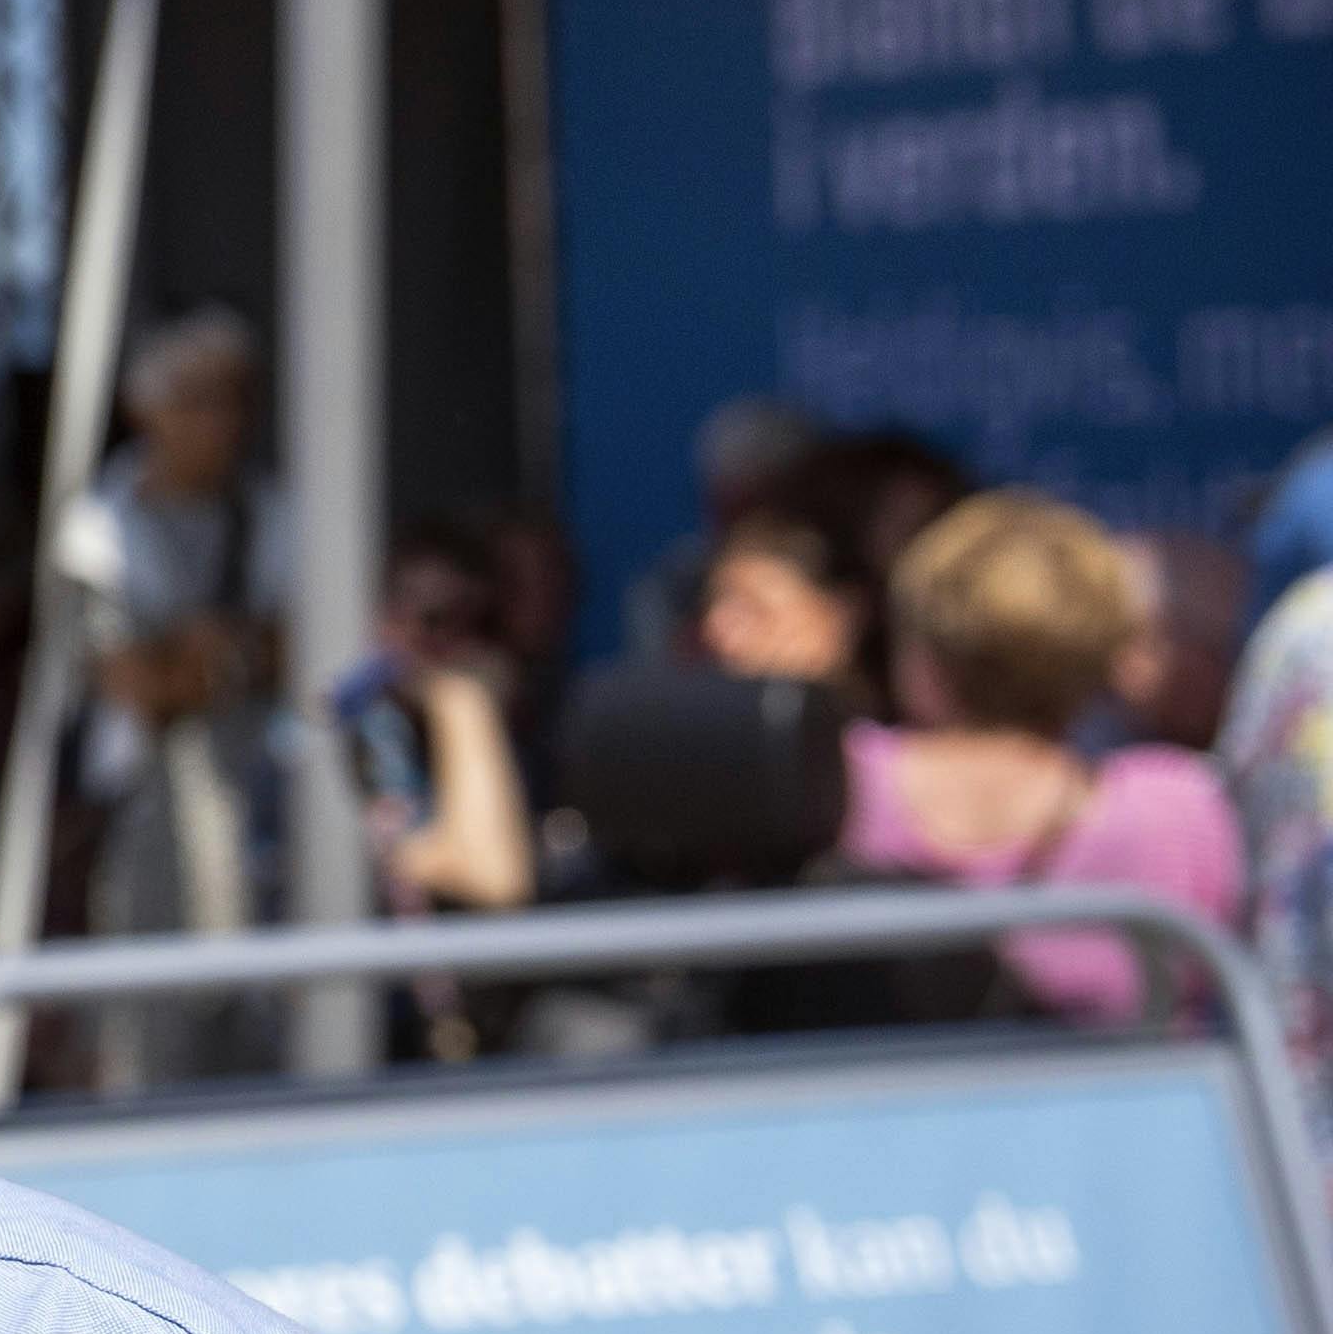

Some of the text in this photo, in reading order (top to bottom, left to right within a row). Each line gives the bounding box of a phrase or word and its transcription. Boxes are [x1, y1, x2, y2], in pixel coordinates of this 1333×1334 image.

[827, 73, 1195, 224] verden.
[415, 1225, 781, 1329] debatter
[786, 1207, 954, 1299] kan
[963, 1195, 1081, 1287] du
